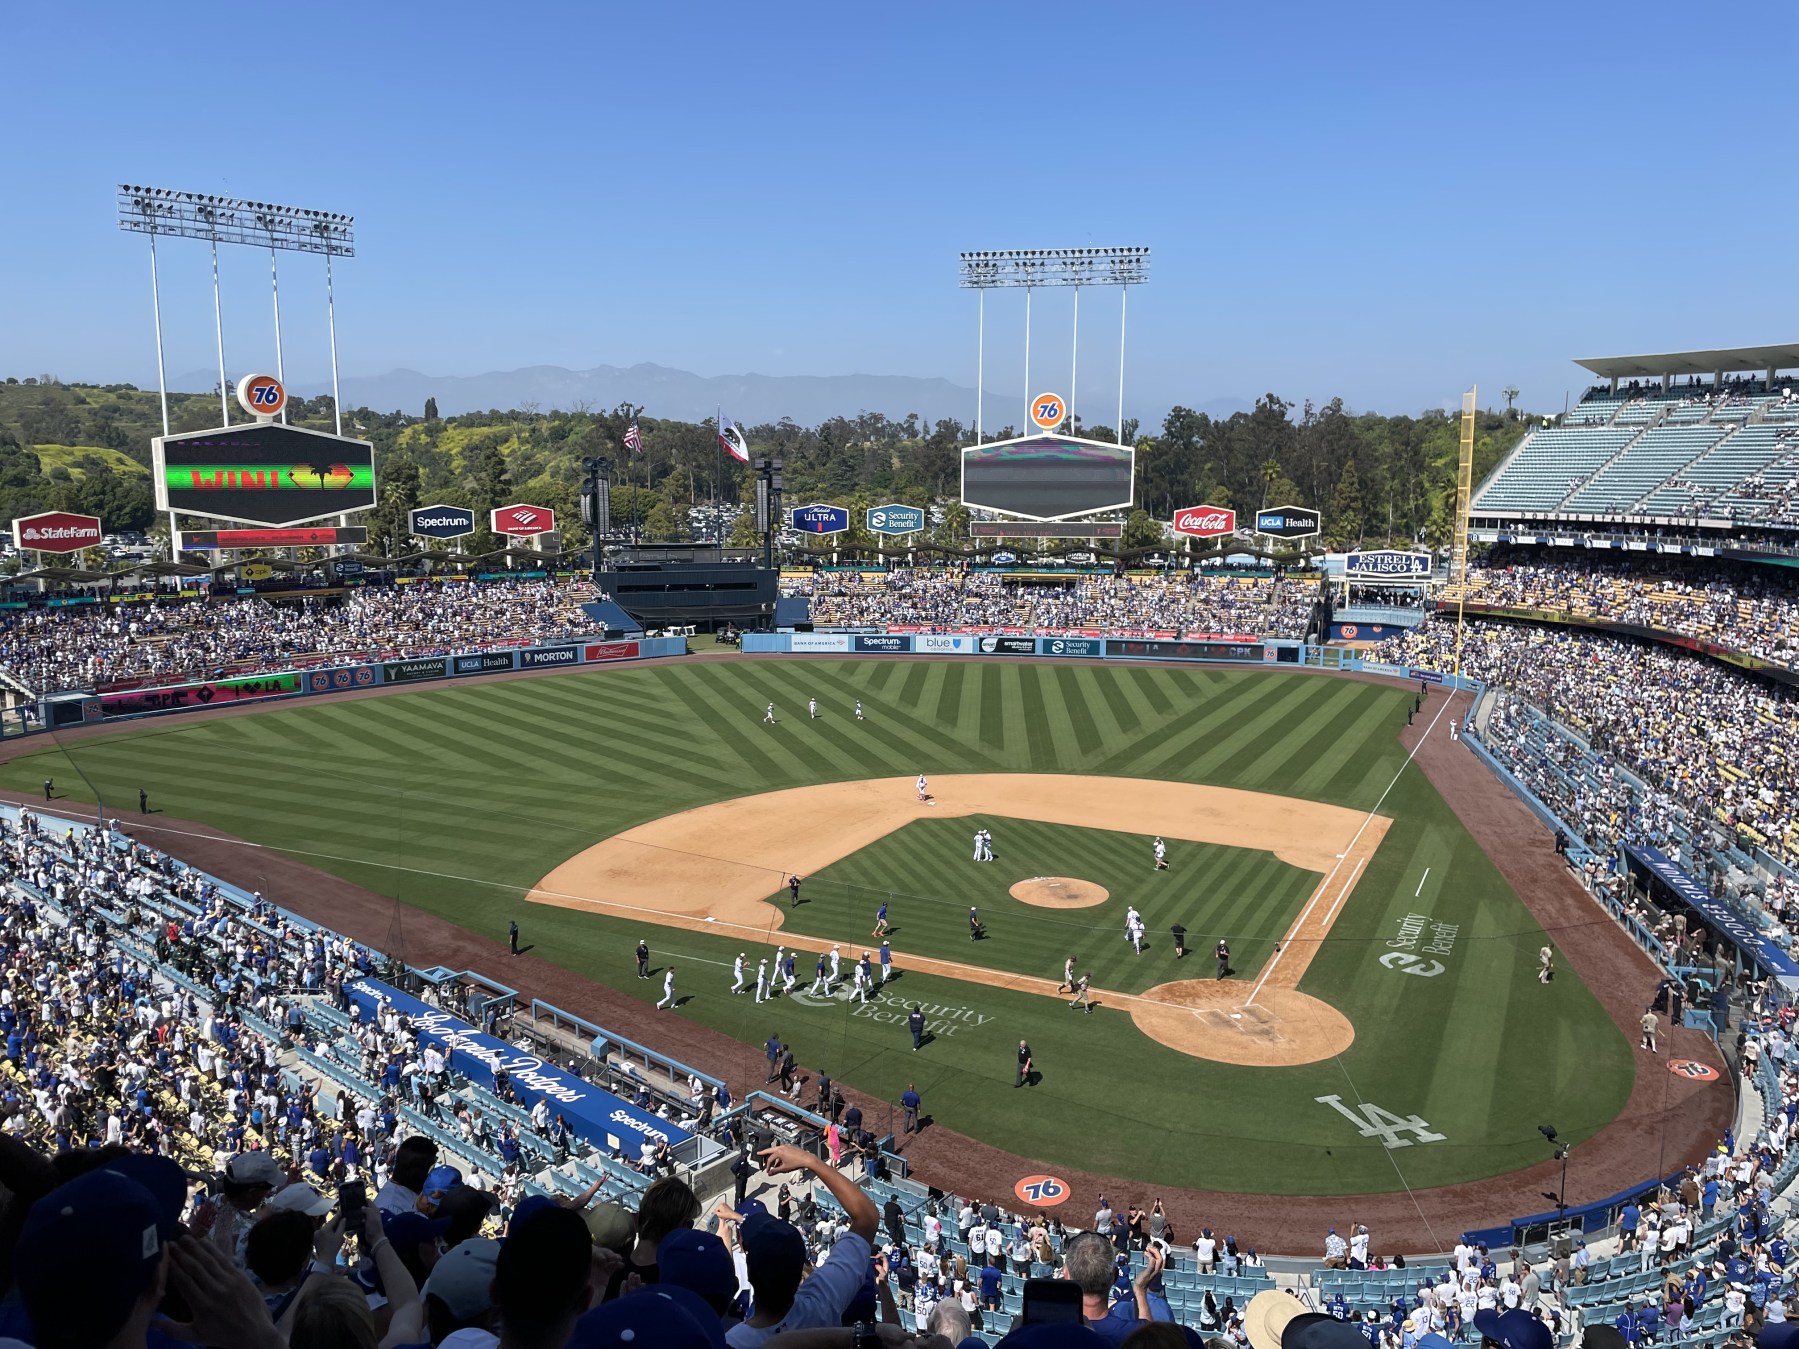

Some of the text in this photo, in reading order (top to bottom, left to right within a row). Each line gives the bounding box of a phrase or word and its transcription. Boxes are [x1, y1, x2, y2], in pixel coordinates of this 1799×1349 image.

[252, 384, 280, 406] 76
[1037, 401, 1060, 420] 76
[804, 513, 836, 521] ULTRA
[888, 511, 919, 521] Security
[417, 516, 467, 528] Spectrum
[888, 520, 916, 528] Benefit
[1261, 518, 1315, 528] UCLA Health
[255, 568, 269, 576] cpk
[1352, 563, 1407, 572] JALISCO
[1343, 627, 1355, 635] 76
[863, 637, 899, 646] Spectrum
[926, 638, 951, 647] blue
[1065, 641, 1091, 649] Security
[534, 650, 574, 662] MORTON
[1266, 650, 1276, 658] 76
[461, 657, 509, 668] UCLA Health
[336, 673, 349, 684] 76
[357, 671, 371, 681] 76
[265, 680, 282, 693] LA
[315, 677, 327, 687] 76
[1653, 862, 1766, 946] DODGER STADIUM
[1386, 912, 1434, 950] Security
[1422, 922, 1460, 956] Benefit
[871, 990, 996, 1027] Security
[411, 1011, 452, 1031] Los
[502, 1056, 587, 1103] Dodgers
[1677, 1061, 1711, 1078] 76
[1314, 1094, 1448, 1149] LA
[610, 1110, 669, 1144] Spectrum
[1023, 1178, 1063, 1202] 76
[975, 1234, 985, 1242] 61
[1468, 1276, 1477, 1284] 22
[1465, 1299, 1475, 1308] 22
[917, 1306, 928, 1316] 50
[1332, 1311, 1344, 1320] 50
